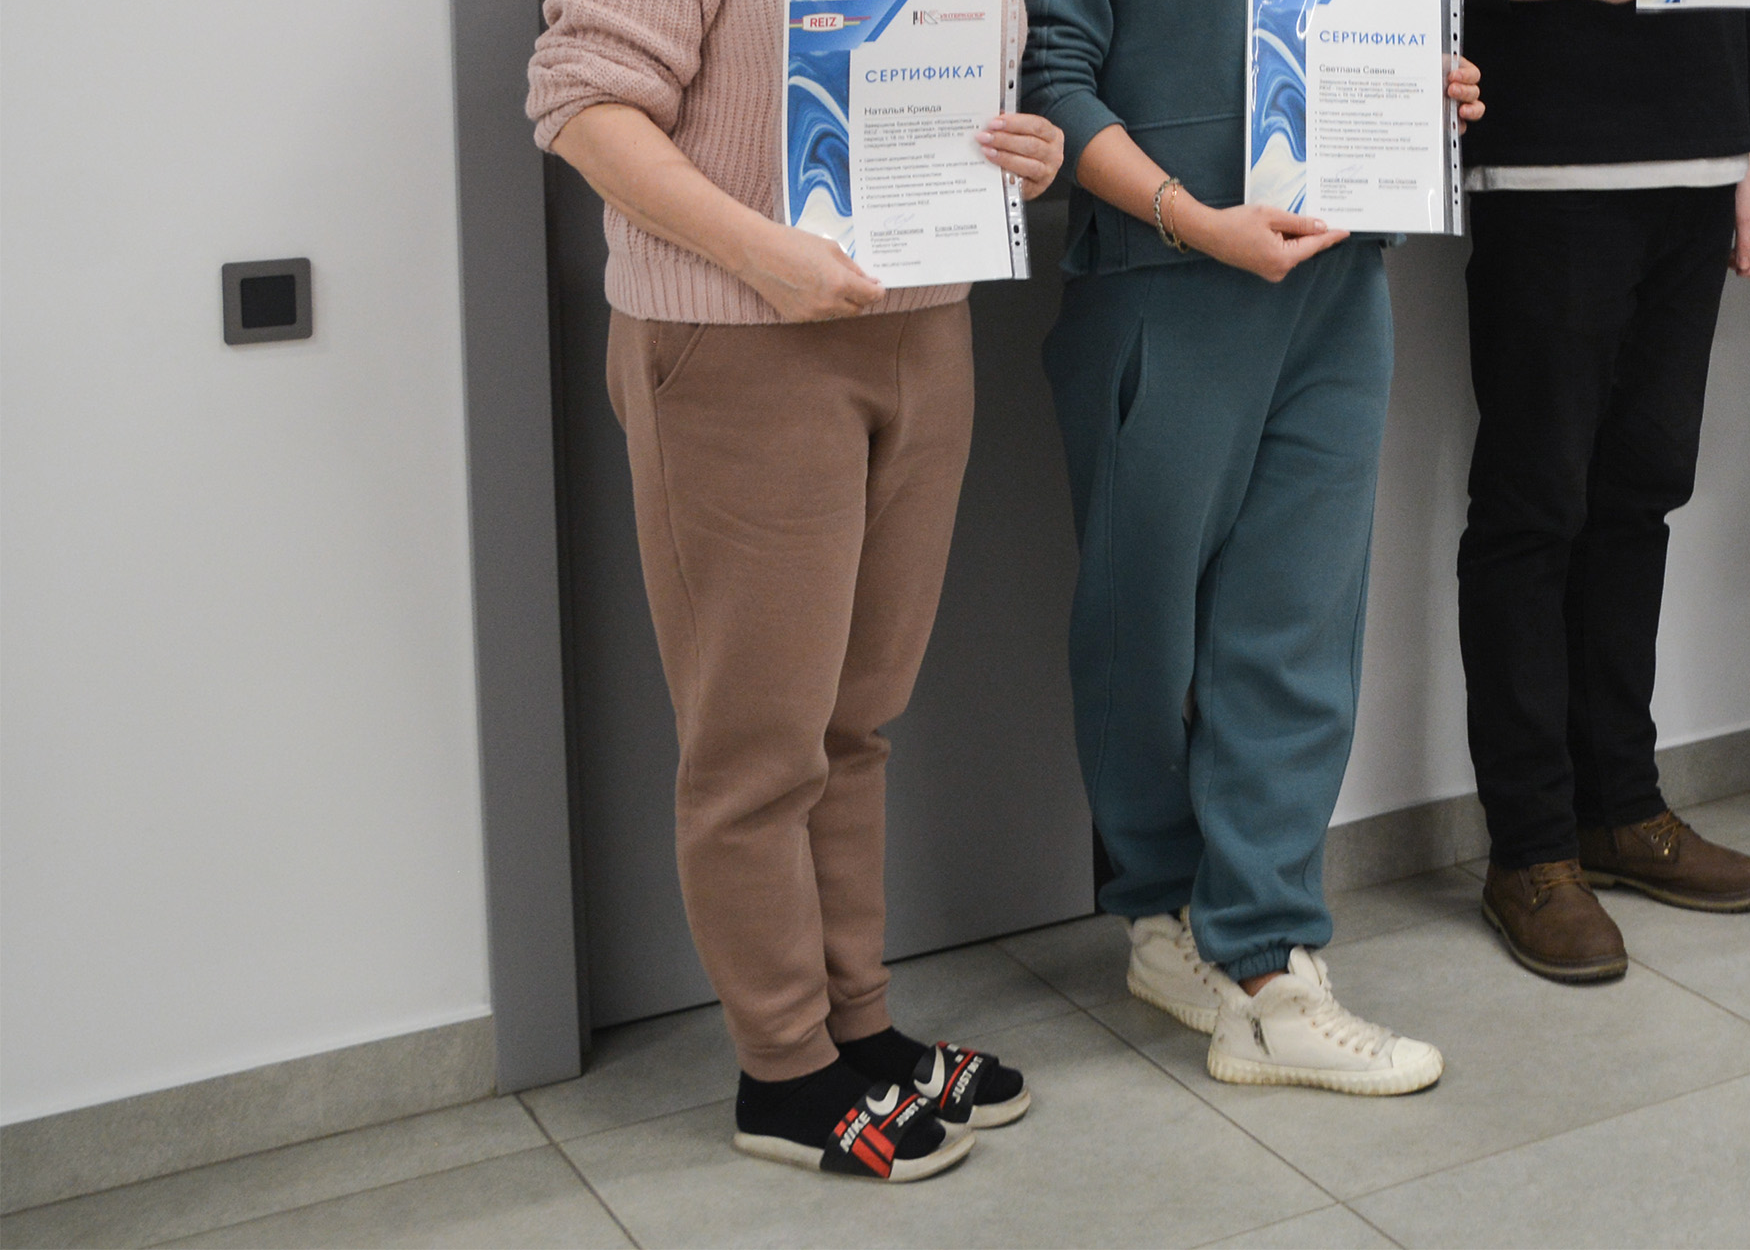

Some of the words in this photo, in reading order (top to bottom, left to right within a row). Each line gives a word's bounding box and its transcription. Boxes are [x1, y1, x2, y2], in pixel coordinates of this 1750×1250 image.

[809, 15, 837, 28] REIZ
[1319, 30, 1426, 46] СЕРТИФИКАТ
[865, 64, 984, 83] СЕРТИФИКАТ
[1319, 64, 1361, 74] Светлана
[1363, 65, 1396, 75] Савина
[864, 106, 905, 116] Наталья
[907, 104, 942, 115] Кривда
[839, 1110, 871, 1154] NIKE
